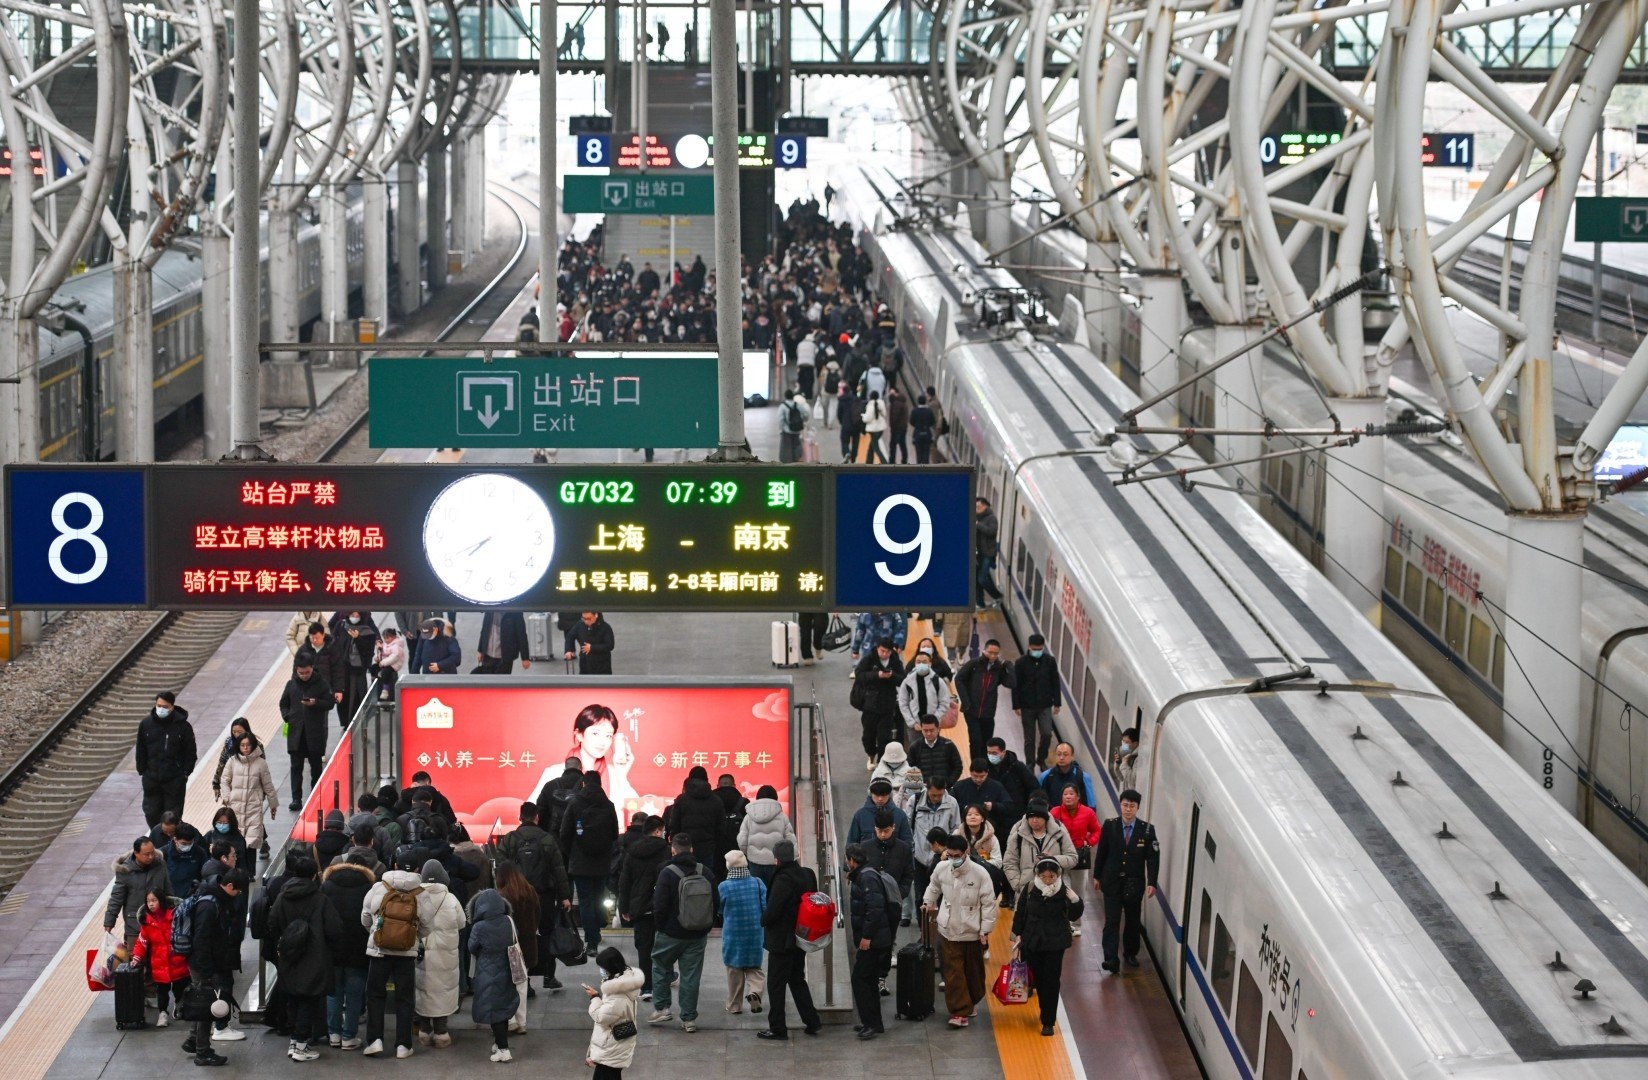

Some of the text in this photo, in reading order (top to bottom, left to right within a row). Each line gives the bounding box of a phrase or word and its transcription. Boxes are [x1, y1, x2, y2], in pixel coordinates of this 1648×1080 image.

[585, 138, 603, 164] 8
[781, 139, 799, 165] 9
[1445, 137, 1470, 164] 11
[635, 181, 685, 197] 出站口
[533, 372, 641, 407] 出站口
[533, 412, 576, 432] Exit
[242, 481, 336, 505] 站台严禁
[559, 480, 795, 508] G7032 07:39 到
[48, 492, 108, 584] 8
[195, 525, 384, 549] 竖立高举杆状物品
[588, 523, 646, 552] 上海
[734, 522, 791, 551] 南京
[872, 493, 933, 586] 9
[183, 569, 396, 593] 骑行平衡车、滑板等
[798, 571, 824, 592] 请
[435, 750, 537, 769] 认养一头牛
[670, 750, 773, 769] 新年万事牛
[1543, 748, 1553, 789] 088
[1259, 923, 1291, 1012] 和谐号
